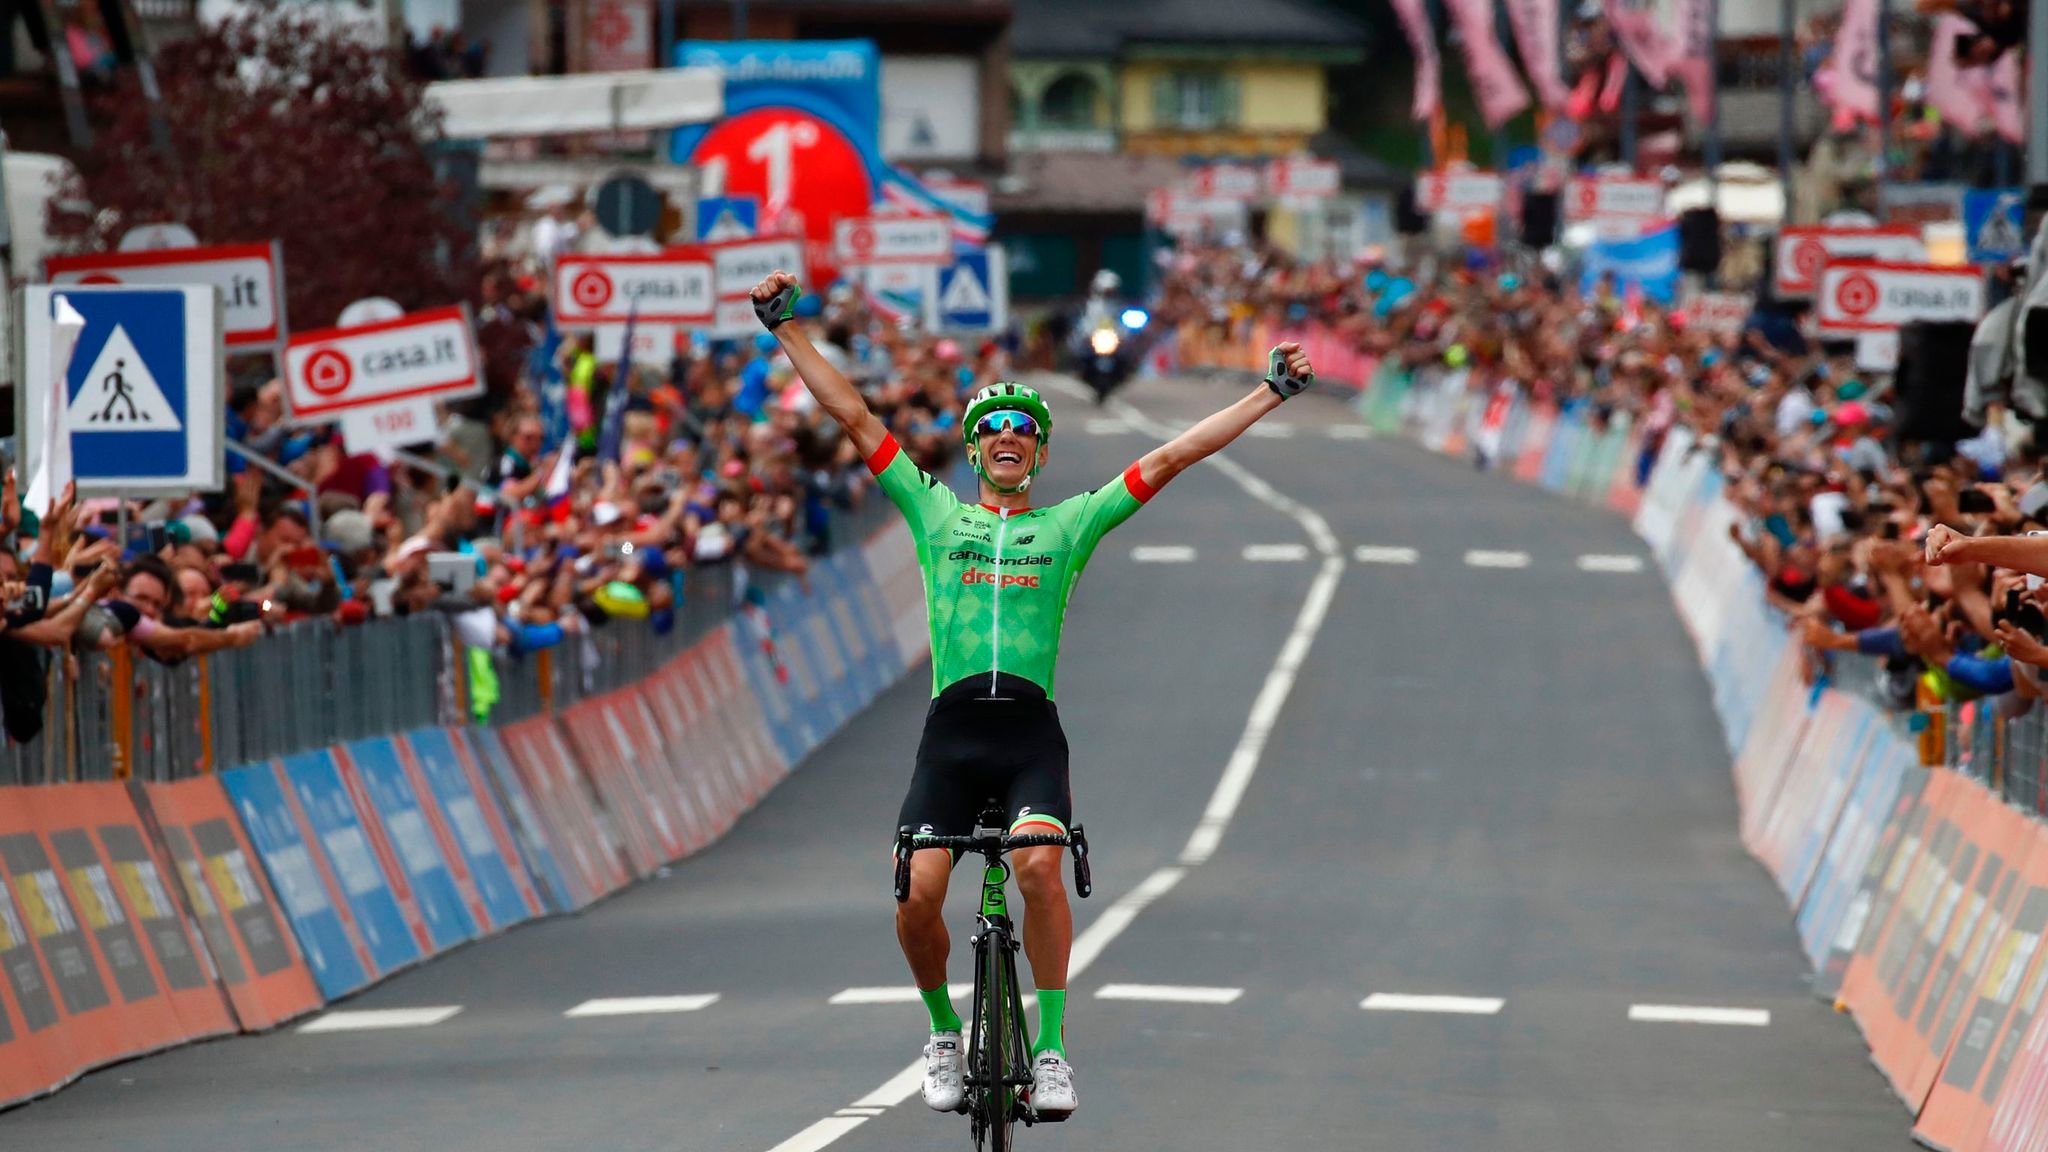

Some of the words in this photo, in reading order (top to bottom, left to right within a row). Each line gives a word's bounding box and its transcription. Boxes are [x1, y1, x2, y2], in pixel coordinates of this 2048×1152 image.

[224, 274, 259, 308] .it
[622, 278, 703, 299] casa.it
[361, 337, 456, 377] casa.it
[952, 529, 992, 542] GARMIN
[948, 550, 1053, 566] cannondale
[961, 566, 1039, 588] dropac
[936, 1041, 956, 1050] SIDI
[1039, 1057, 1060, 1067] SIDI
